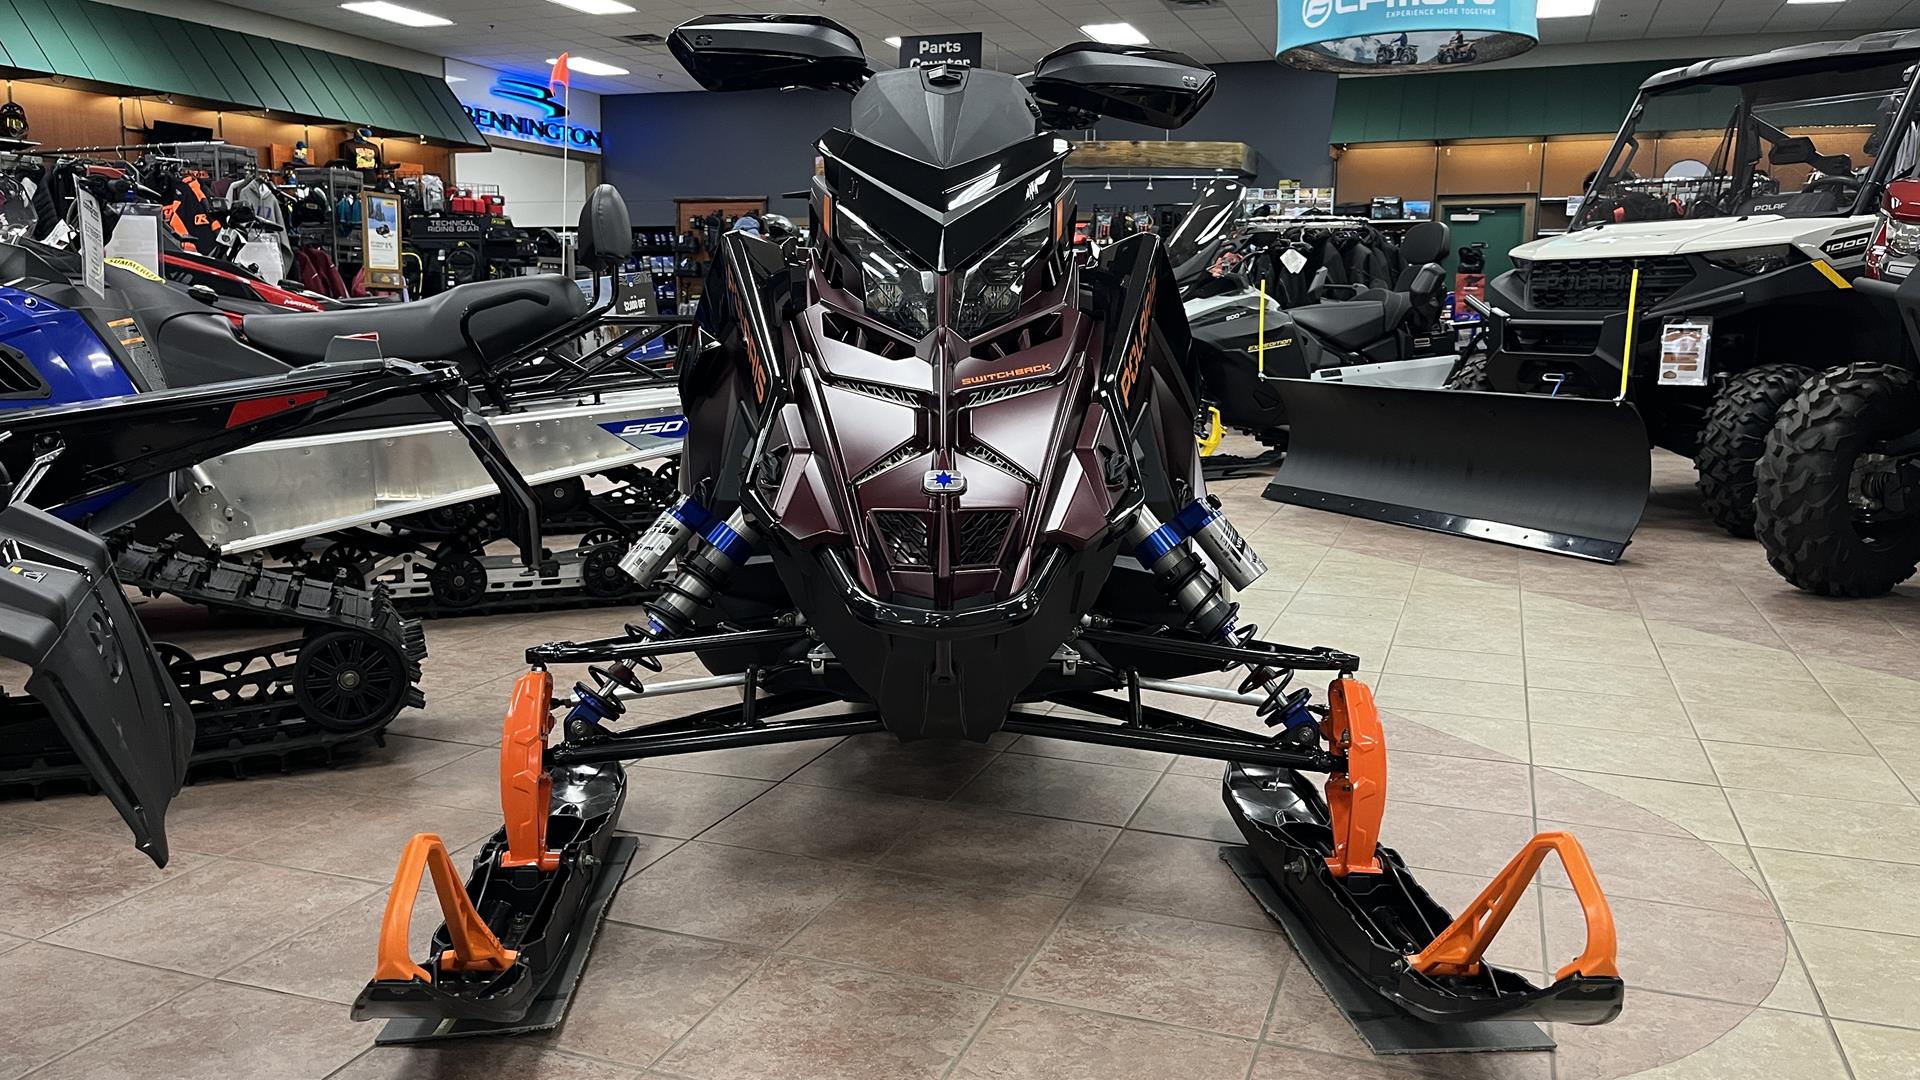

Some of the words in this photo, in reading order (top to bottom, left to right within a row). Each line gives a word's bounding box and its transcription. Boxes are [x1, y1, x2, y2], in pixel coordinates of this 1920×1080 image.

[1386, 8, 1434, 18] EXPERIENCE
[1461, 8, 1496, 16] TOGETHER
[919, 41, 962, 54] Parts
[1826, 237, 1869, 253] 1000
[961, 363, 1052, 385] SWITCHBACK
[620, 420, 684, 437] 550
